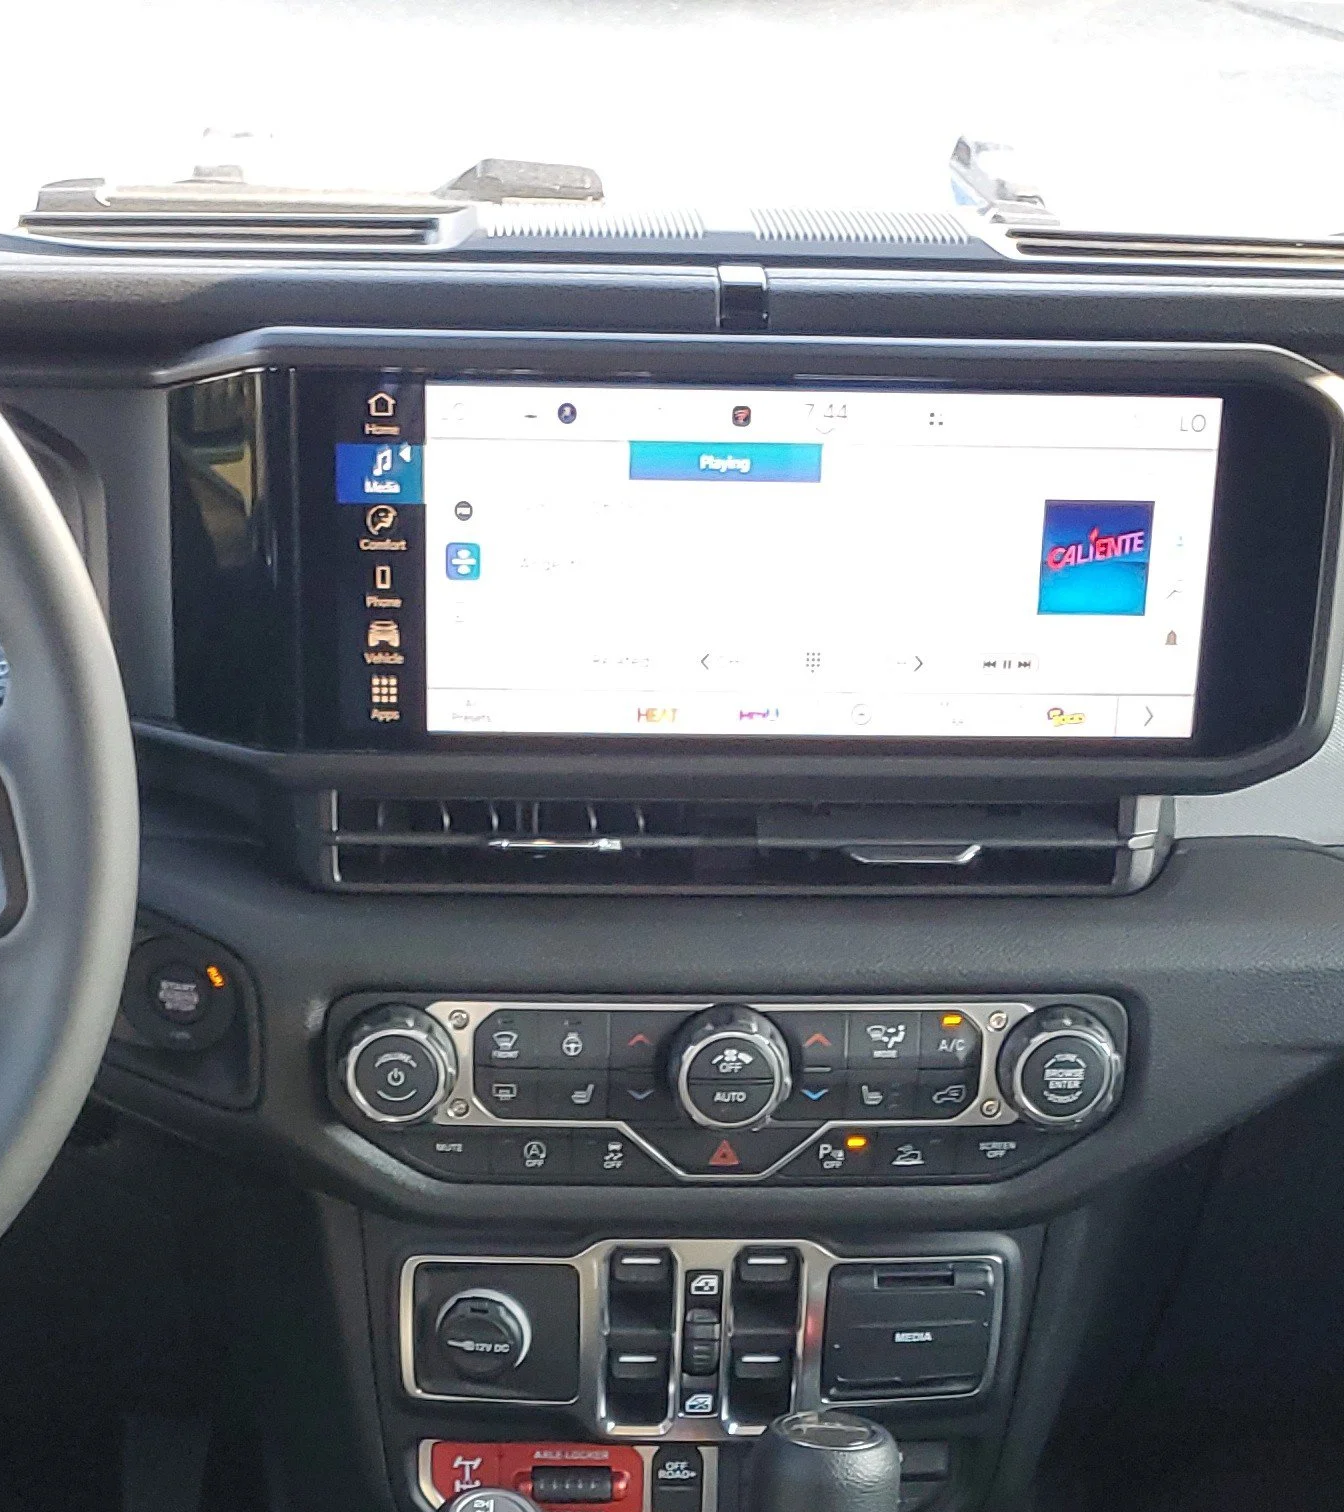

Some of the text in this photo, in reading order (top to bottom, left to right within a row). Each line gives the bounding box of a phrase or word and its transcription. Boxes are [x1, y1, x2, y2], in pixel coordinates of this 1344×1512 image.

[805, 404, 847, 418] 744
[1180, 414, 1206, 432] LO
[699, 453, 752, 474] Playing
[359, 538, 407, 551] Comfort
[1046, 526, 1144, 571] CALIENTE
[938, 1039, 965, 1052] A/C
[718, 1062, 743, 1073] OFF
[713, 1091, 747, 1103] AUTO
[819, 1143, 832, 1160] P
[525, 1159, 544, 1168] OFF
[894, 1331, 932, 1342] MEDIA
[493, 1343, 510, 1353] DC
[665, 1461, 689, 1470] OFF
